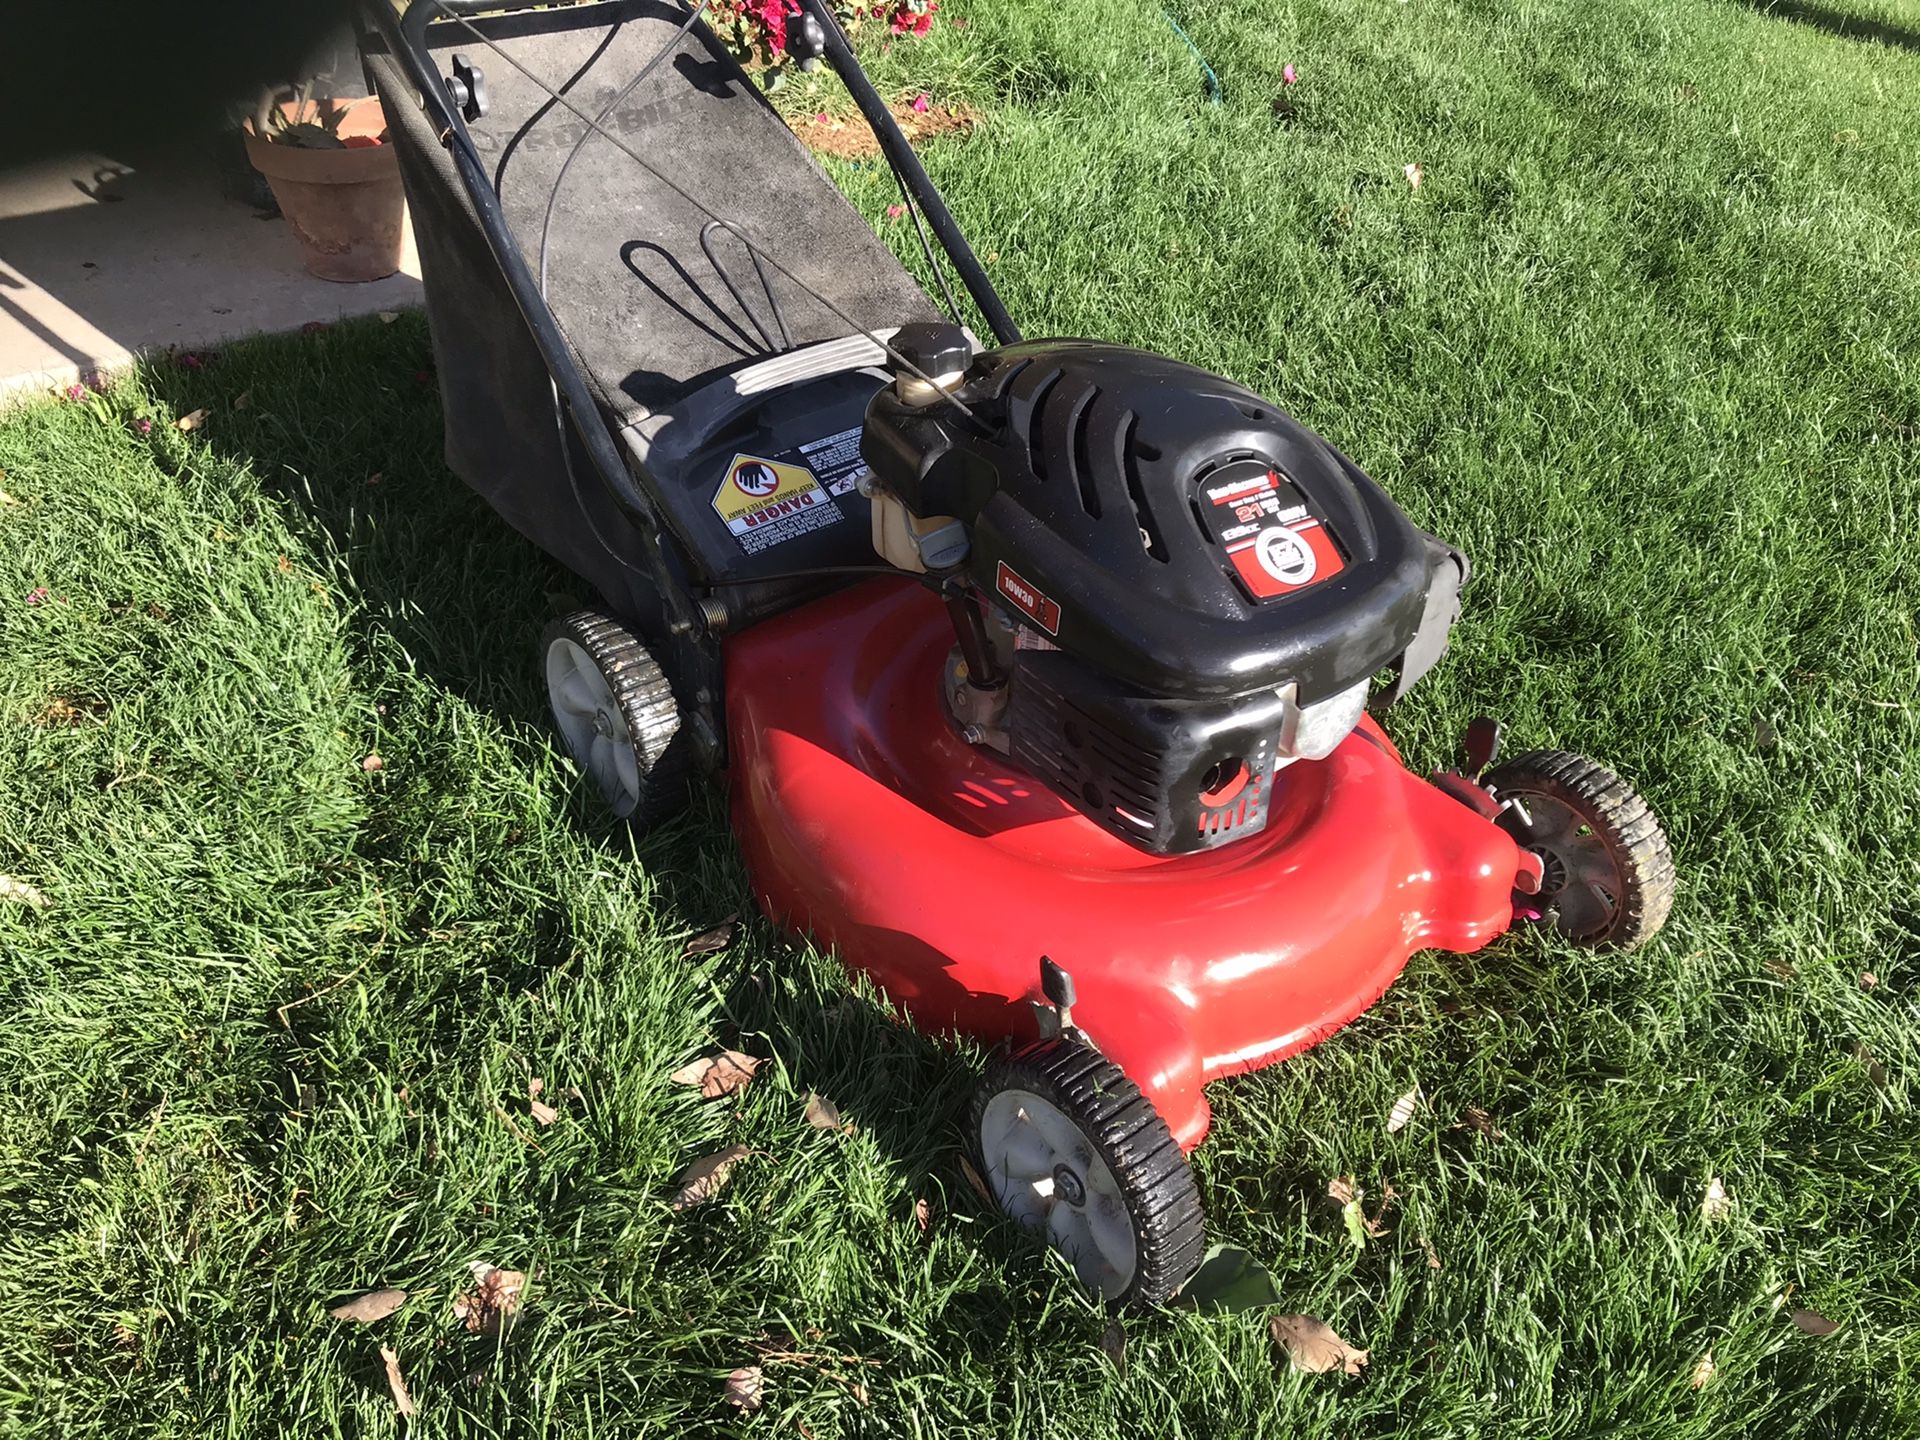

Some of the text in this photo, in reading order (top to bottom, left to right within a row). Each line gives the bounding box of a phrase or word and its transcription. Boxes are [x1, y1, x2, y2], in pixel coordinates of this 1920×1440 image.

[499, 89, 696, 152] TRO-BILT
[775, 489, 798, 501] HANDS
[798, 483, 814, 492] KEEP
[728, 508, 746, 518] AWAY
[742, 493, 814, 528] DANGER
[746, 502, 762, 511] FEET
[1235, 502, 1265, 523] 21
[1004, 576, 1034, 608] 10W30
